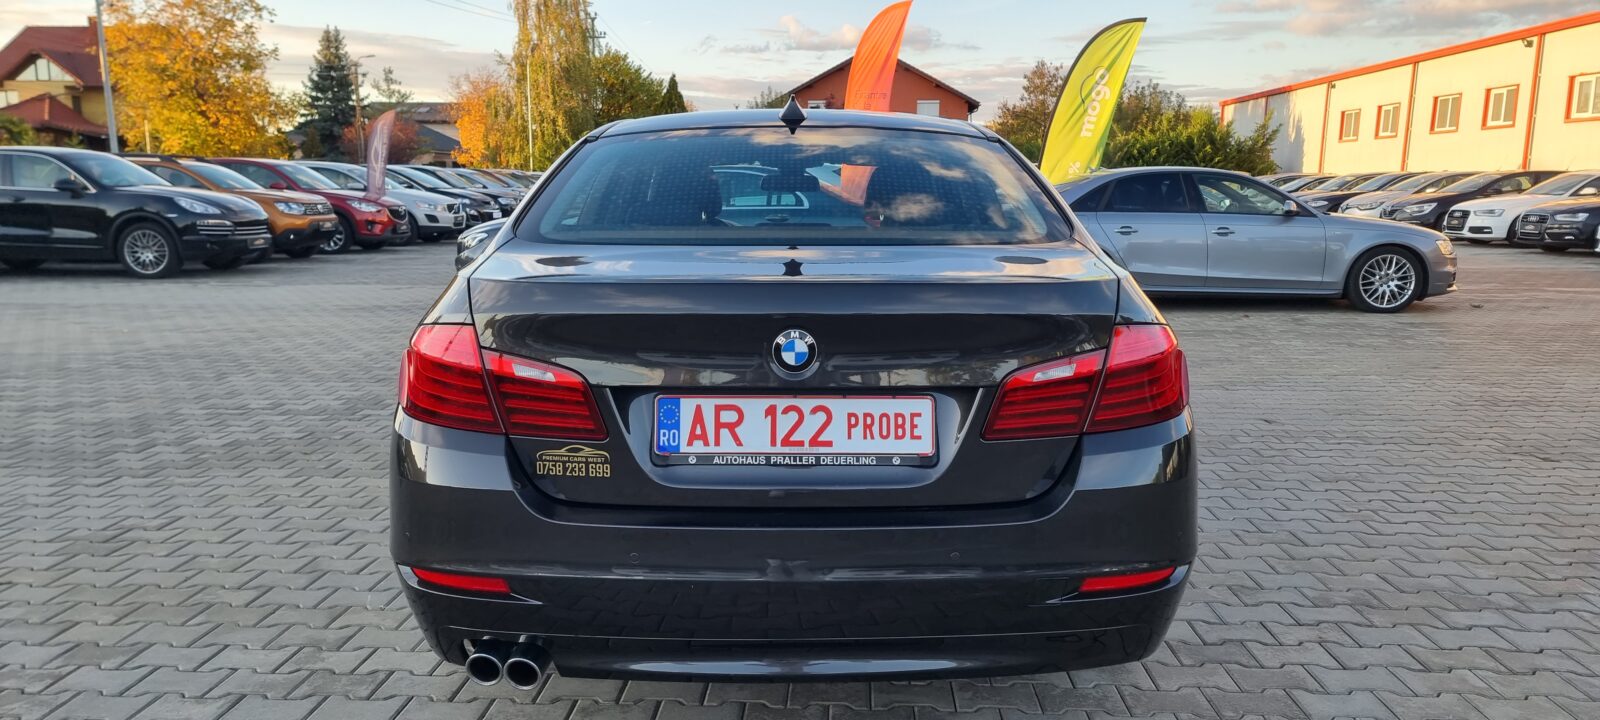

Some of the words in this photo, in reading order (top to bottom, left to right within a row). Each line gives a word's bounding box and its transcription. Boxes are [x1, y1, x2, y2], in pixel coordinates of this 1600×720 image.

[1081, 68, 1110, 137] mogo
[776, 331, 814, 346] BMW
[686, 404, 745, 447] AR
[764, 404, 833, 448] 122
[847, 412, 922, 440] PROBE
[660, 429, 679, 447] RO
[713, 456, 766, 465] AUTOHAUS
[770, 456, 816, 465] PRALLER
[820, 456, 876, 465] DEUERLING
[536, 461, 563, 475] 0758
[566, 462, 586, 476] 233
[589, 463, 610, 478] 699
